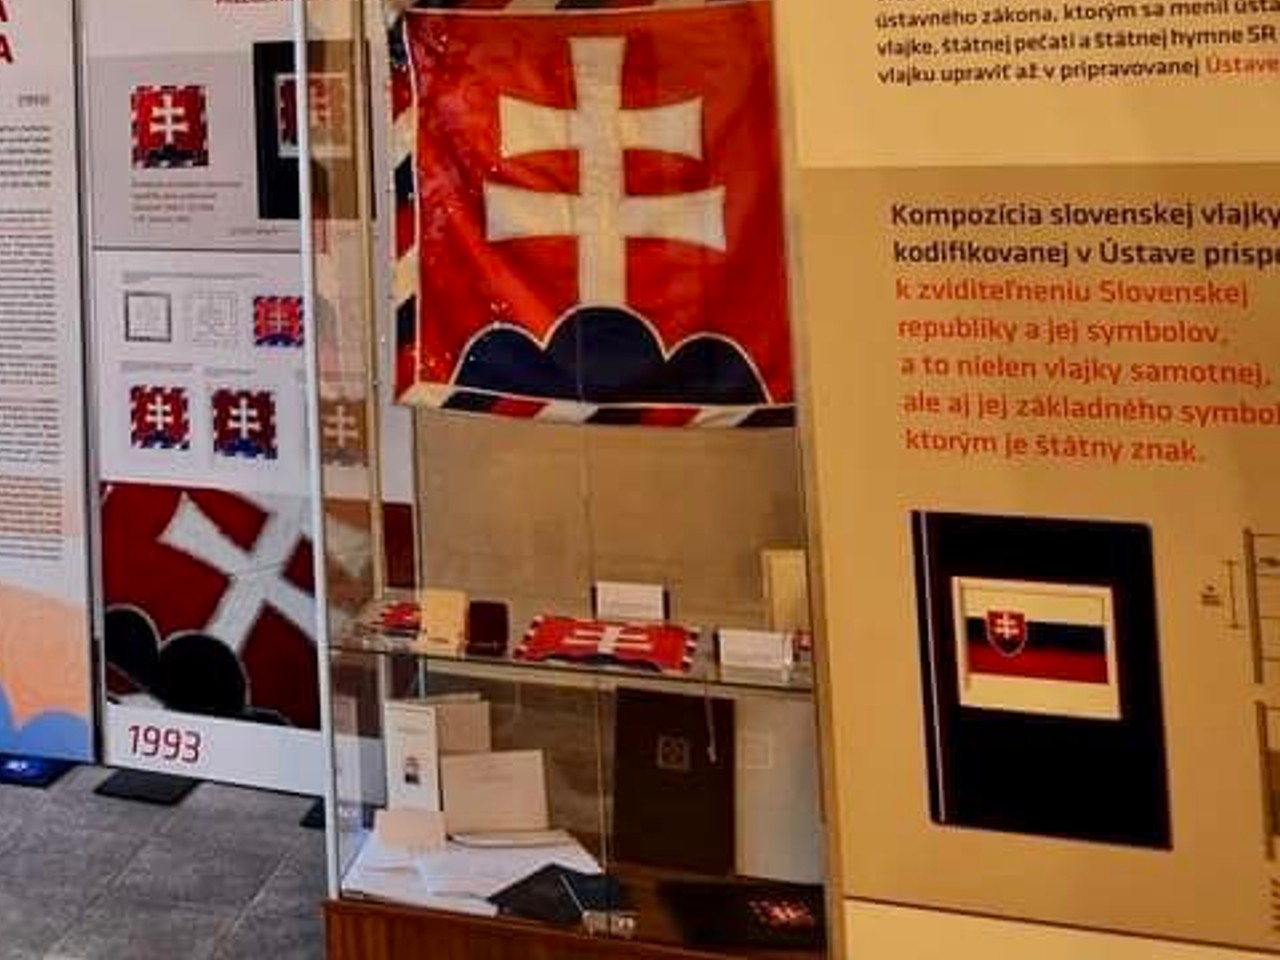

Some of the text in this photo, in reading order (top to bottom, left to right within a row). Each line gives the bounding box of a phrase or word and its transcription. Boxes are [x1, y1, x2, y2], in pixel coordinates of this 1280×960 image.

[875, 10, 977, 29] ústavného
[981, 6, 1058, 24] zákona,
[1063, 1, 1137, 22] ktorým
[1140, 3, 1165, 18] sa
[877, 24, 1276, 58] vlajke, štátnej pečati a štátnej hymne SR
[877, 65, 935, 87] vlajku
[941, 63, 1013, 84] upraviť
[1015, 62, 1037, 80] až
[1042, 65, 1055, 80] v
[1061, 57, 1199, 82] pripravovanej
[891, 202, 1280, 230] Kompozícia slovenskej vlajky
[893, 240, 1069, 268] kodifikovanej
[1077, 246, 1092, 263] v
[1099, 238, 1195, 265] Ústave
[896, 277, 1249, 309] k zviditeľneniu Slovenskej
[898, 317, 1229, 346] republiky a jej symbolov,
[901, 356, 1272, 389] a to nielen vlajky samotnej,
[903, 391, 1280, 428] ale aj jej základného symbol
[905, 429, 1205, 464] ktorým je štátny znak.
[128, 725, 202, 764] 1993
